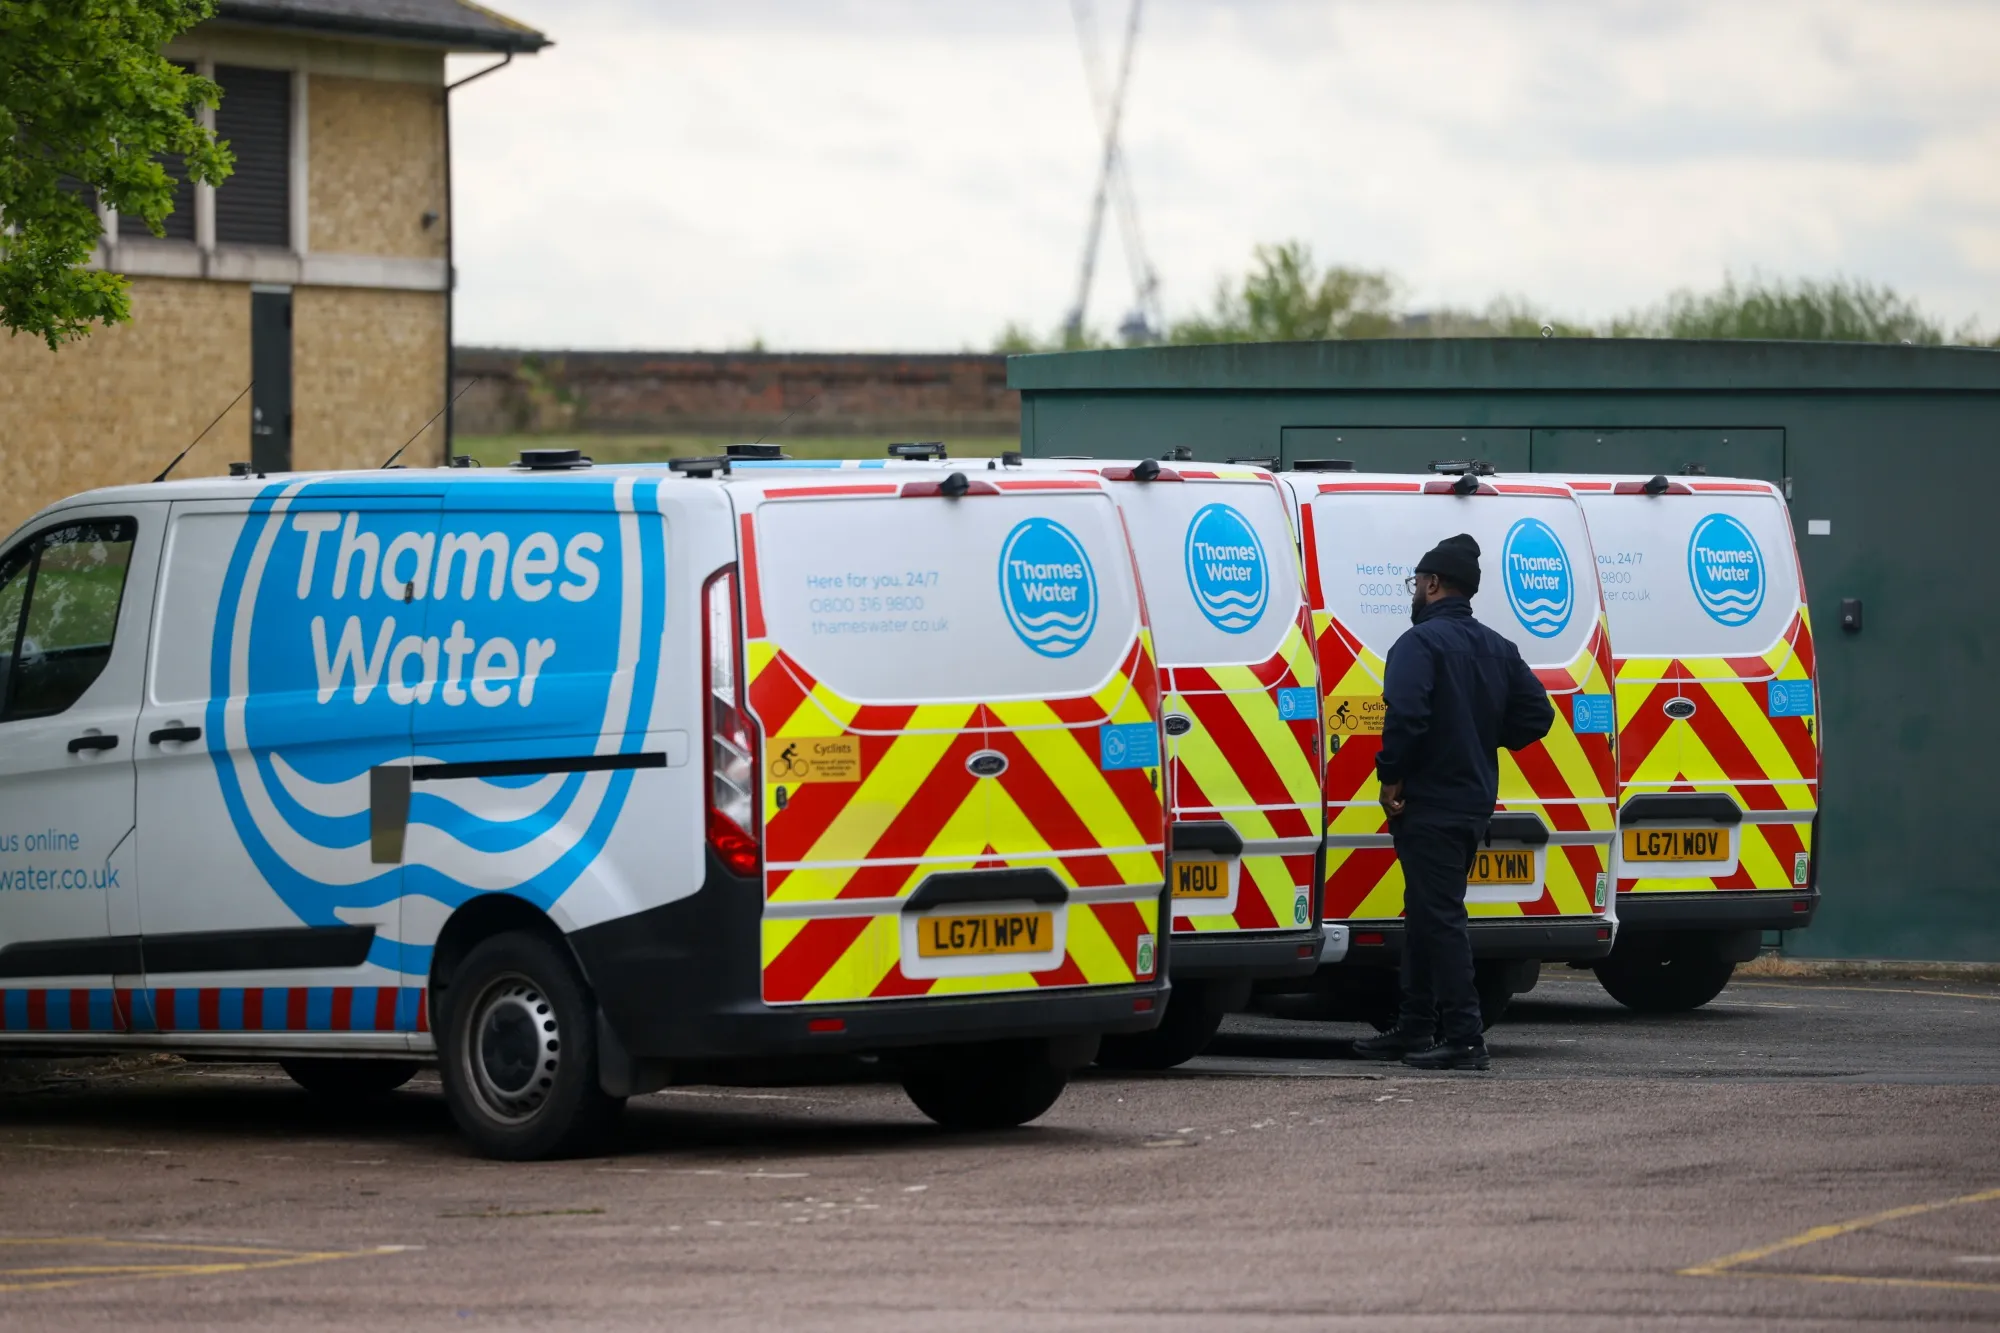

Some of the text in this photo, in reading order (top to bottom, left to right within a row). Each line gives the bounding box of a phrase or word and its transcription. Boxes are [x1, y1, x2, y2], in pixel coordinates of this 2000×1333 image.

[292, 511, 604, 602] Thames
[1194, 542, 1256, 561] Thames
[1595, 552, 1643, 567] ou, 24/7
[1697, 547, 1754, 564] Thames
[1010, 560, 1083, 580] Thames
[1356, 563, 1384, 576] Here
[1387, 562, 1403, 576] for
[1511, 553, 1563, 571] Thames
[806, 574, 843, 589] Here
[847, 572, 868, 588] for
[906, 571, 939, 588] 24/7
[1205, 563, 1252, 582] Water
[1520, 573, 1560, 590] Water
[1601, 571, 1631, 584] 9800
[1706, 565, 1750, 582] Water
[1022, 582, 1078, 602] Water
[1603, 588, 1651, 601] ter.co.uk
[859, 596, 882, 612] 316
[886, 595, 924, 611] 9800
[812, 616, 949, 634] thameswater.co.uk
[311, 615, 556, 707] Water
[813, 743, 852, 756] Cyclists
[24, 828, 80, 852] online
[1636, 831, 1719, 856] LG71 WOV
[1494, 854, 1528, 879] YWN
[1179, 865, 1218, 892] WOU
[1296, 904, 1307, 920] 70
[934, 916, 1039, 950] LG71 WPV
